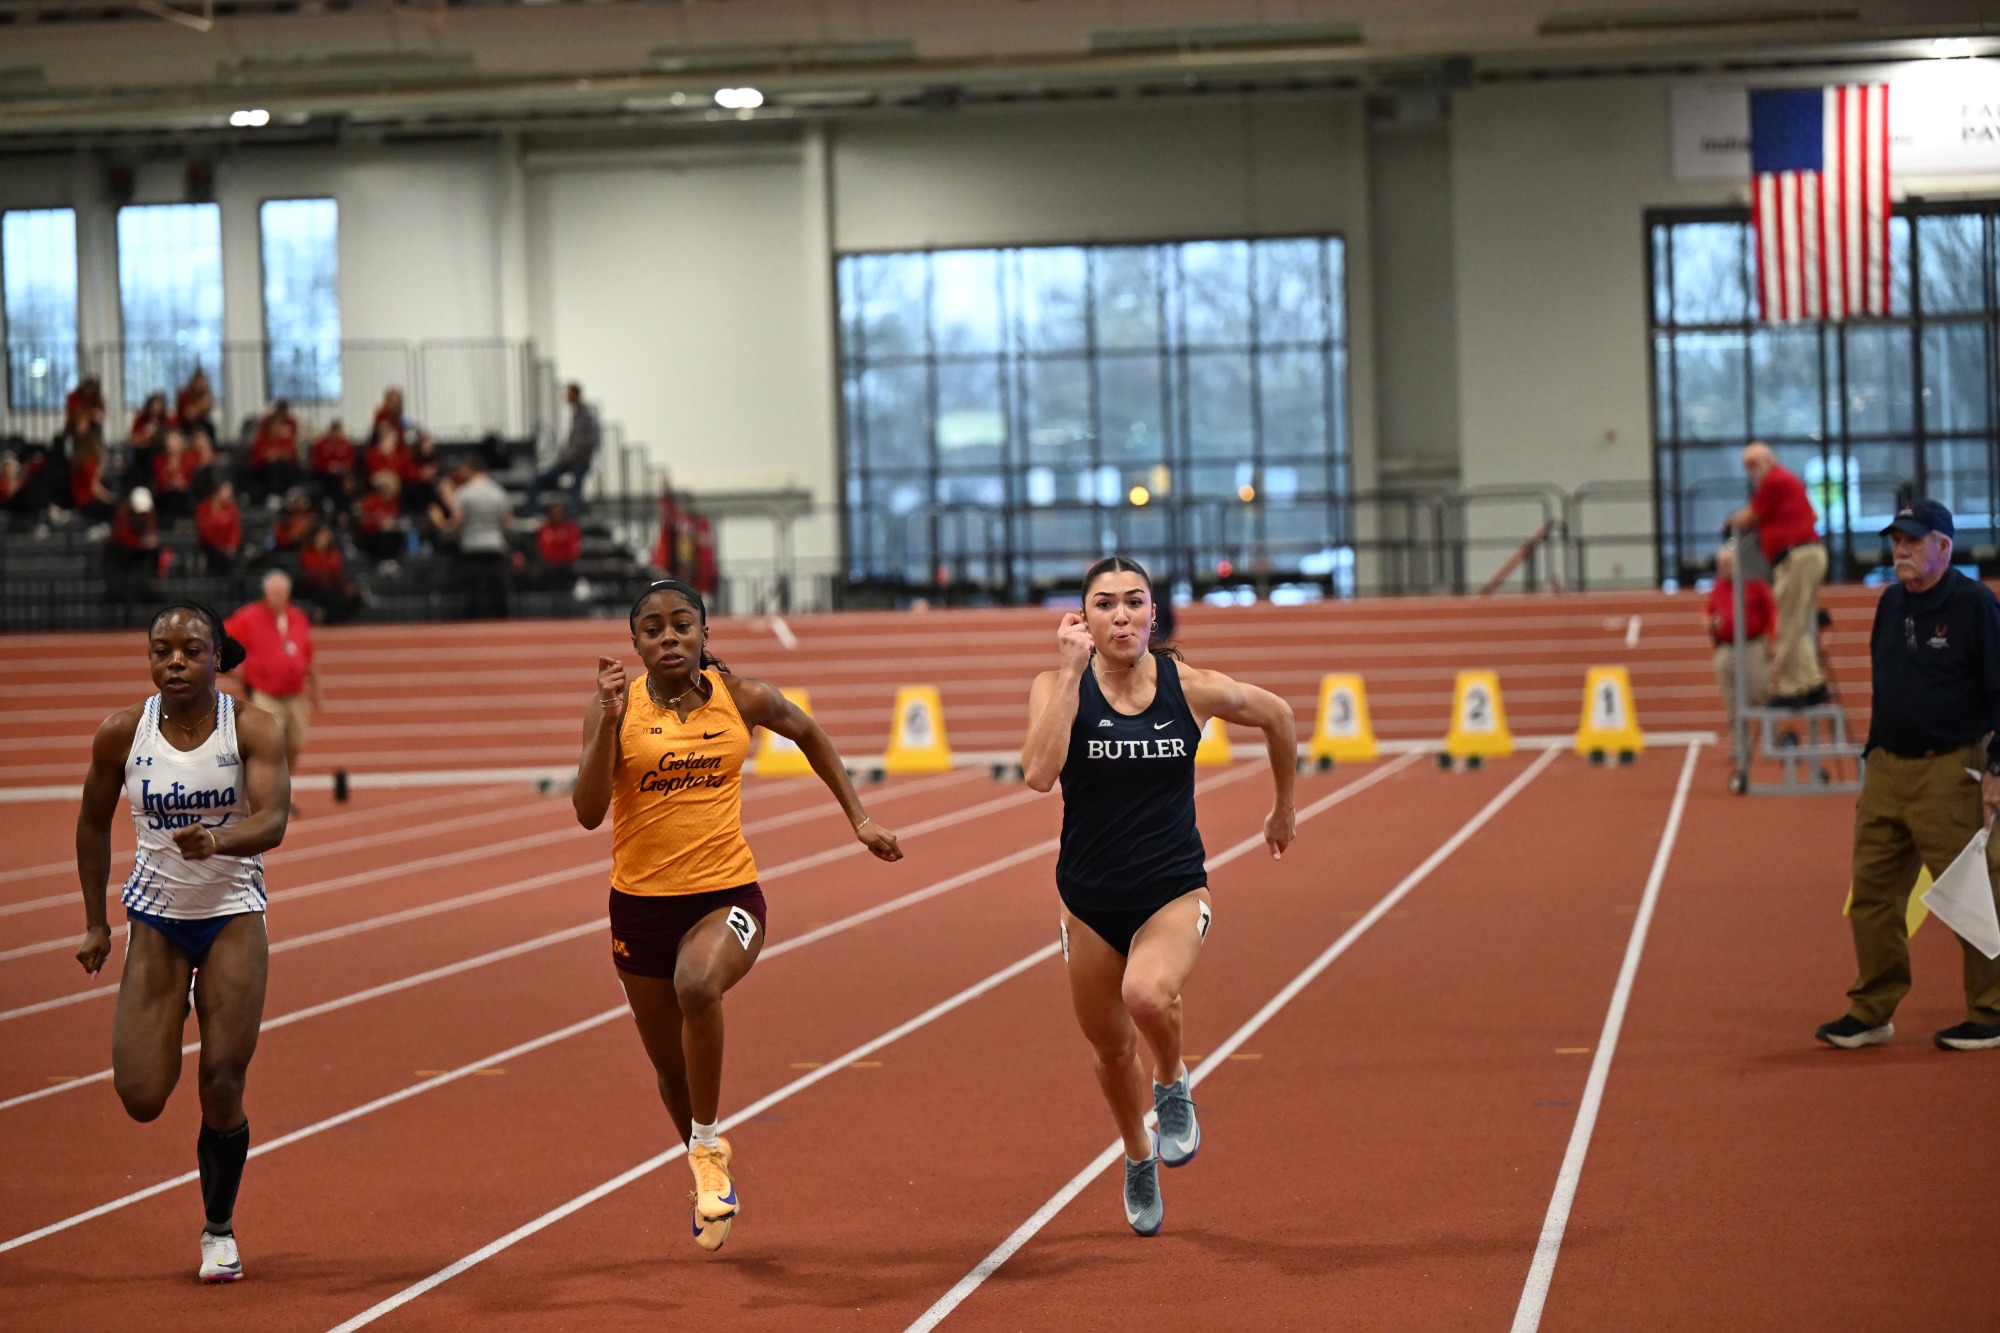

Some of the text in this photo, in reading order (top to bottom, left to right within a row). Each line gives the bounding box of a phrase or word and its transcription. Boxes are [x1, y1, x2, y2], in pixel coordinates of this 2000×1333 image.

[1331, 691, 1352, 723] 3
[1467, 689, 1487, 719] 2
[1601, 686, 1616, 715] 1
[658, 751, 722, 772] Golden
[1087, 738, 1187, 760] BUTLER
[141, 779, 237, 816] Indiana
[640, 771, 728, 796] Gophers
[729, 911, 749, 943] 2
